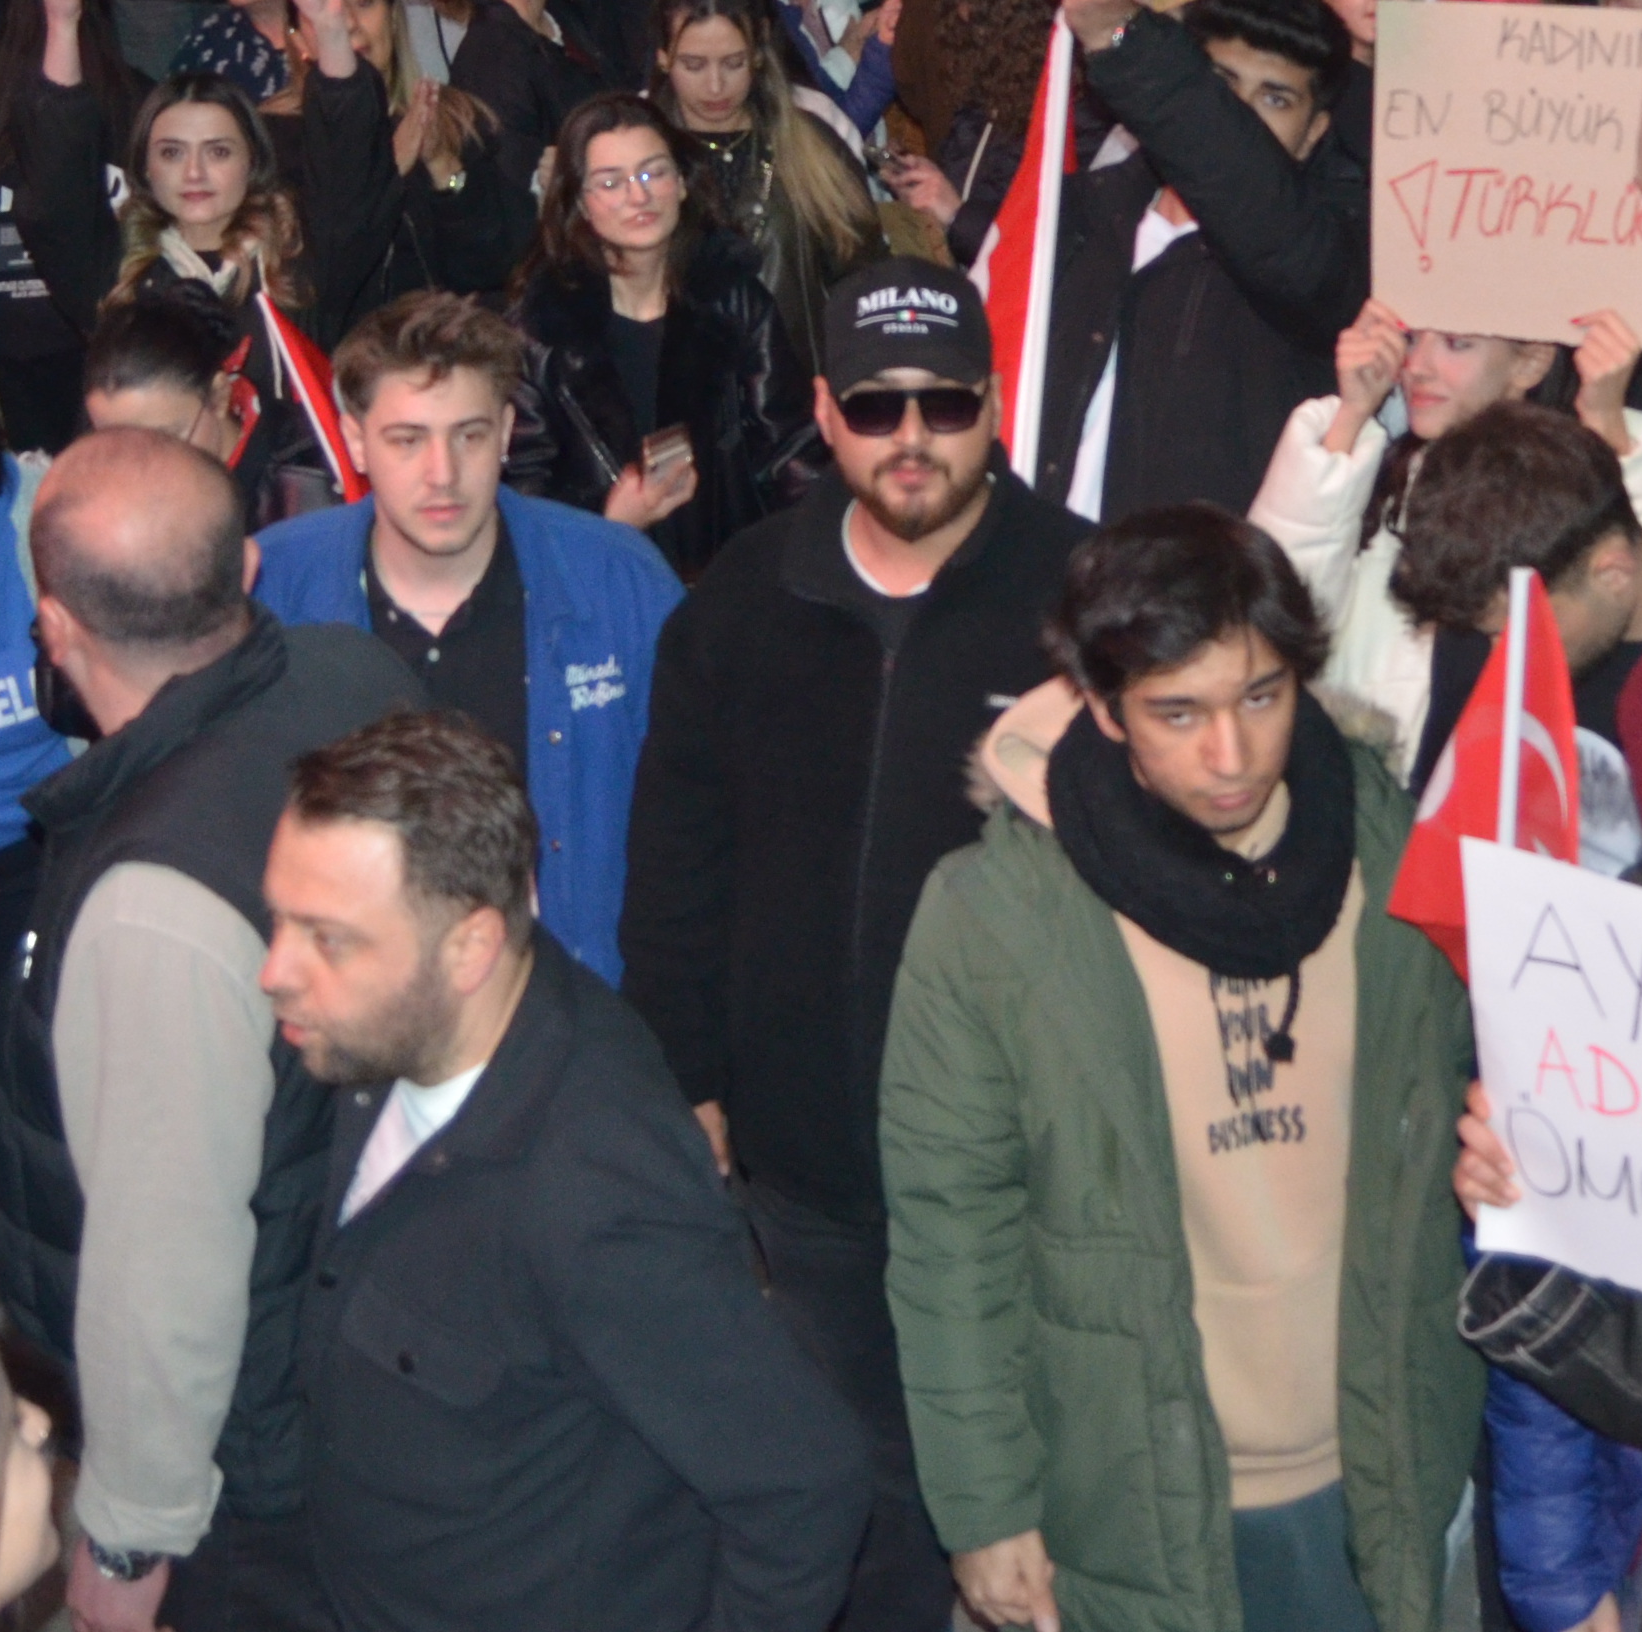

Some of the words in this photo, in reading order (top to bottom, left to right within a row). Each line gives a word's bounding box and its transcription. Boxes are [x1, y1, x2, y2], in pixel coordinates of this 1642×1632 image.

[1382, 88, 1453, 141] EN
[1483, 86, 1624, 153] BÜYÜK
[856, 285, 959, 318] MILANO
